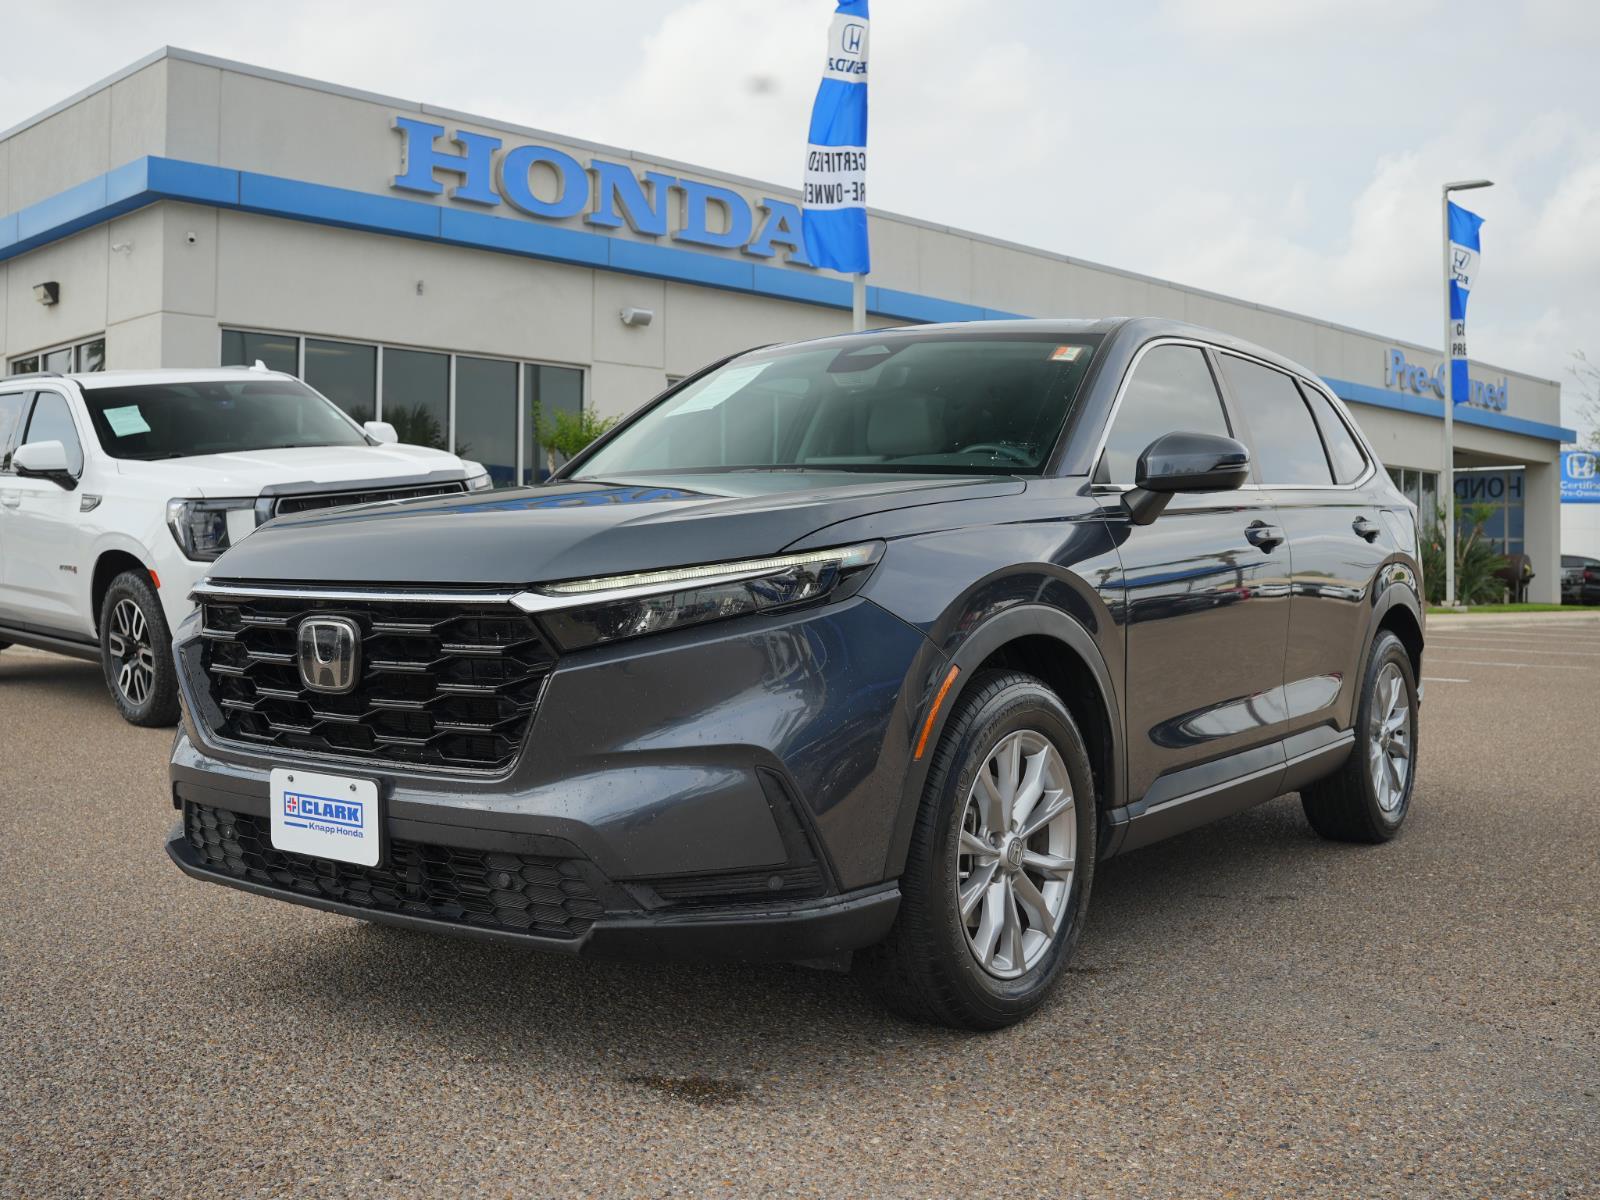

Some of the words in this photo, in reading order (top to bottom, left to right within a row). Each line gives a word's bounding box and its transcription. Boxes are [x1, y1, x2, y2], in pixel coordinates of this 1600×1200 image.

[389, 116, 817, 269] HONDA
[1385, 348, 1508, 411] Pre-ned
[301, 799, 360, 822] CLARK
[308, 822, 335, 834] Knapp
[336, 827, 363, 838] Honda
